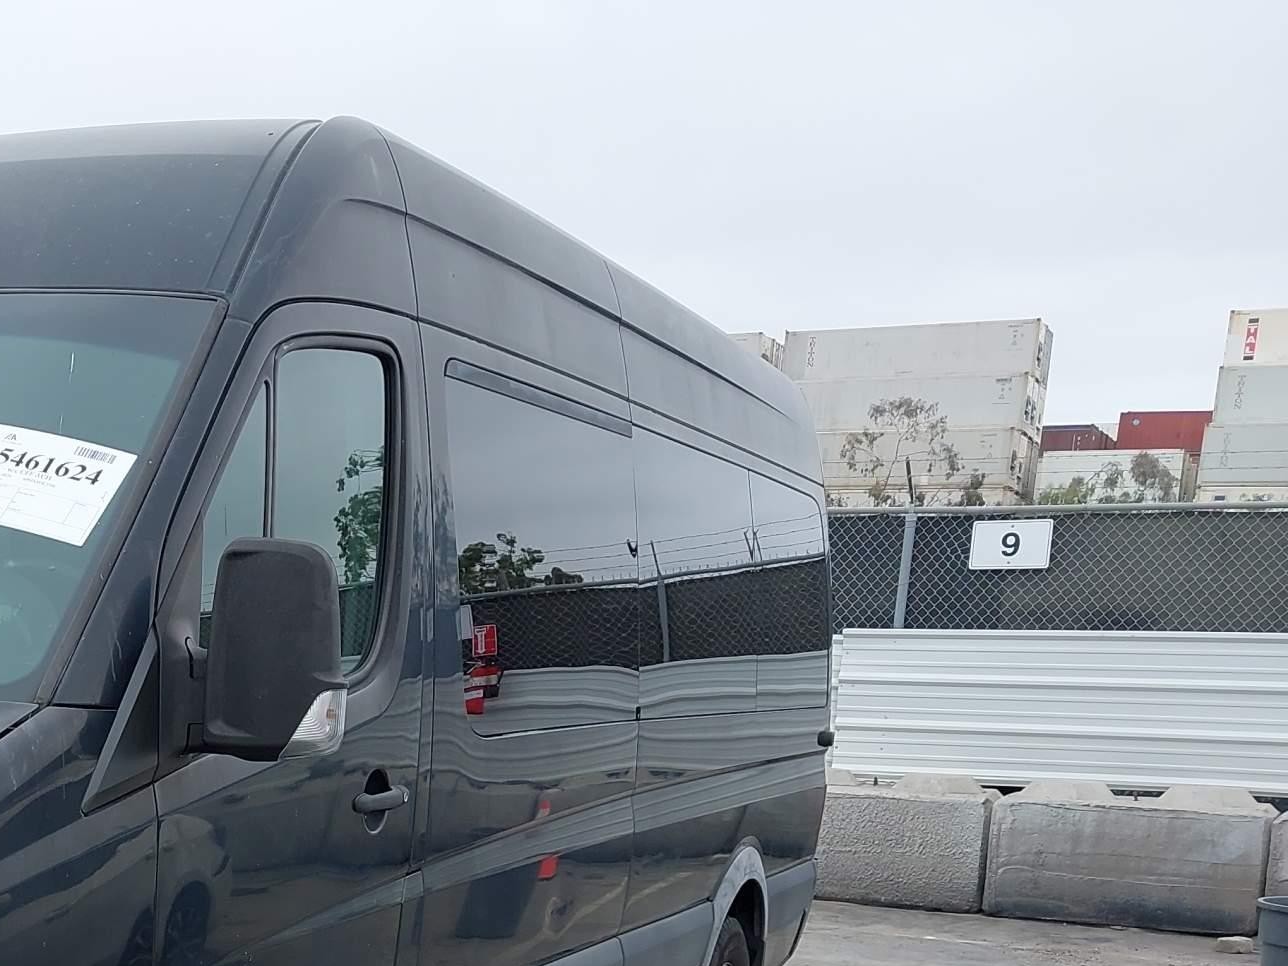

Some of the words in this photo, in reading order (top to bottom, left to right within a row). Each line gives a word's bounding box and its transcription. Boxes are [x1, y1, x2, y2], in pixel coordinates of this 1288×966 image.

[807, 336, 817, 368] TRITON
[1245, 325, 1258, 354] TAL
[1001, 532, 1021, 557] 9
